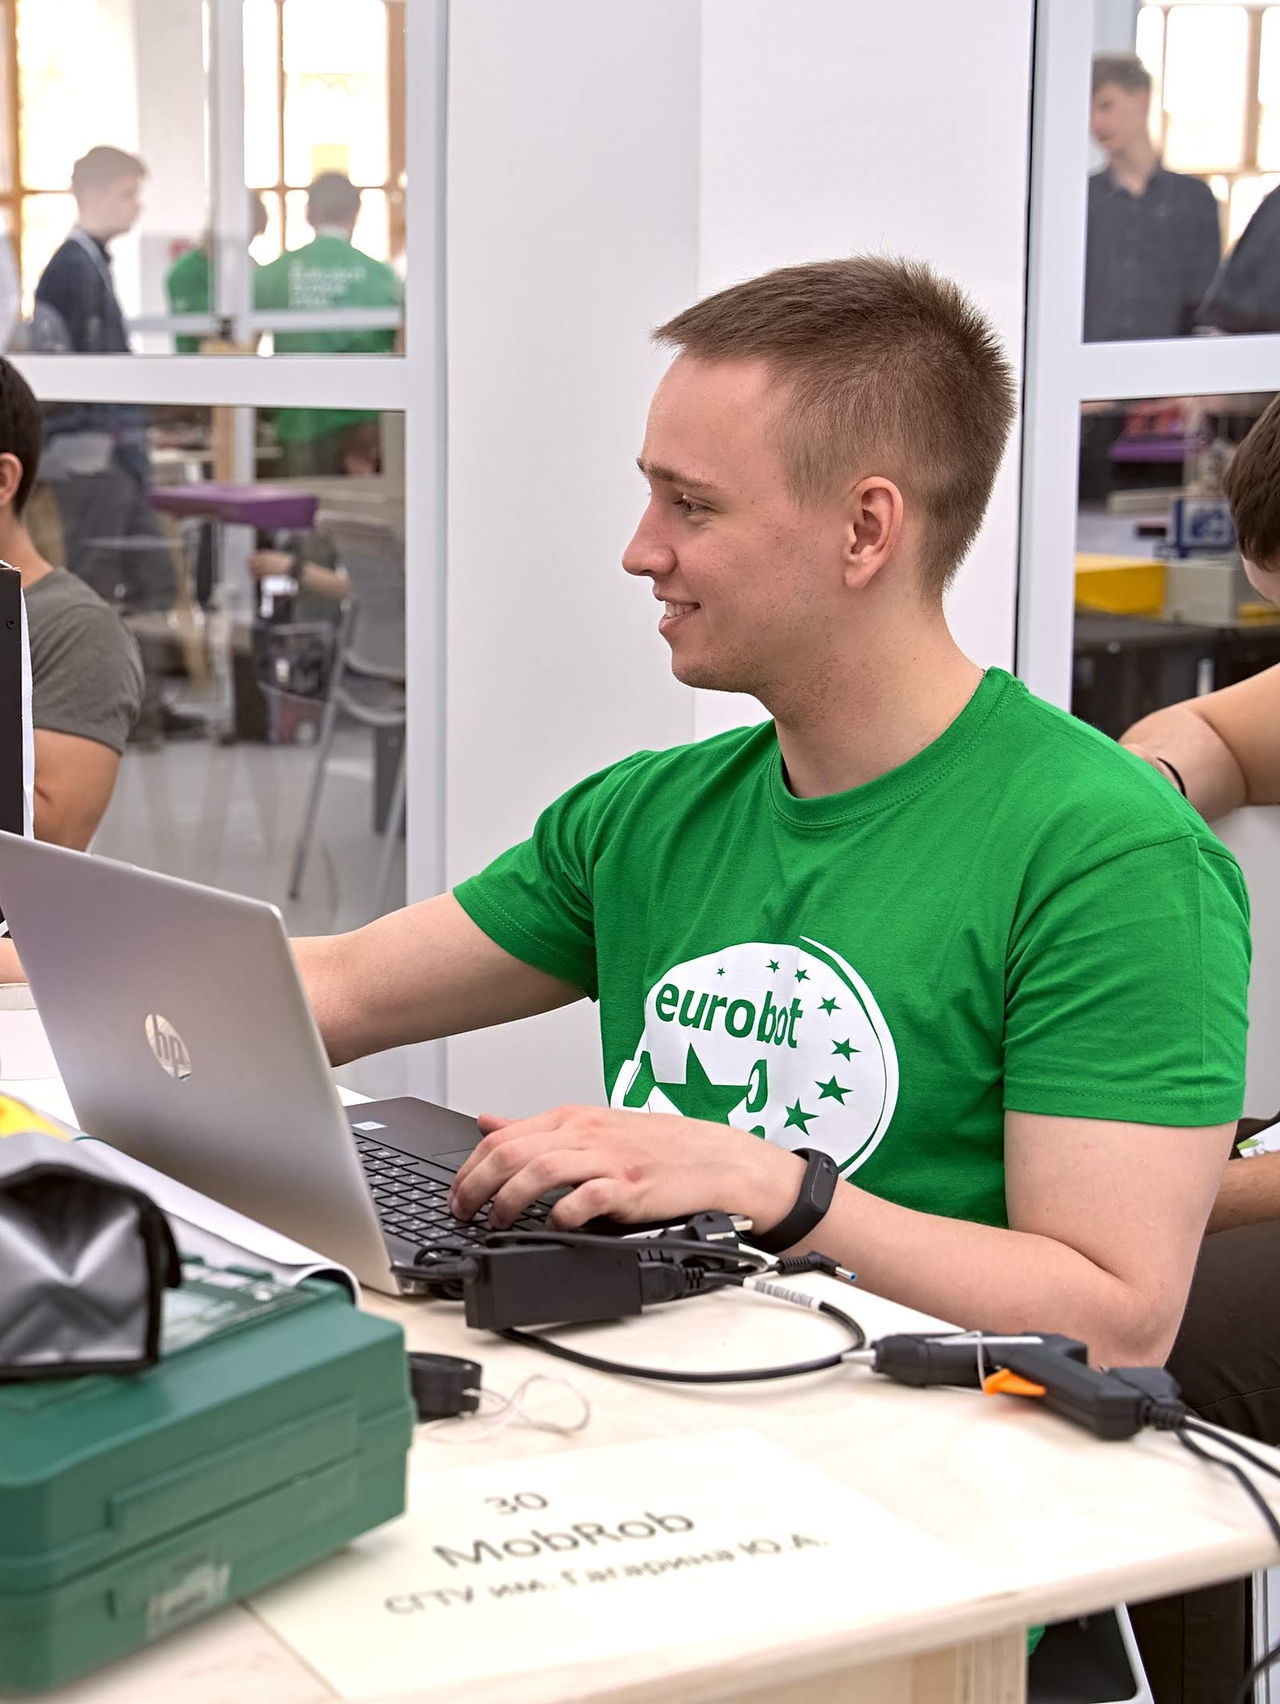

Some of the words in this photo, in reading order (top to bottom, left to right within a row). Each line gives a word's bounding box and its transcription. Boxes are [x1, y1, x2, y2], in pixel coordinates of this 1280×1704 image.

[655, 983, 804, 1049] eurobot
[151, 1013, 187, 1080] hp
[485, 1491, 549, 1515] 30
[432, 1511, 695, 1568] MobRob
[383, 1584, 476, 1616] СГТУ
